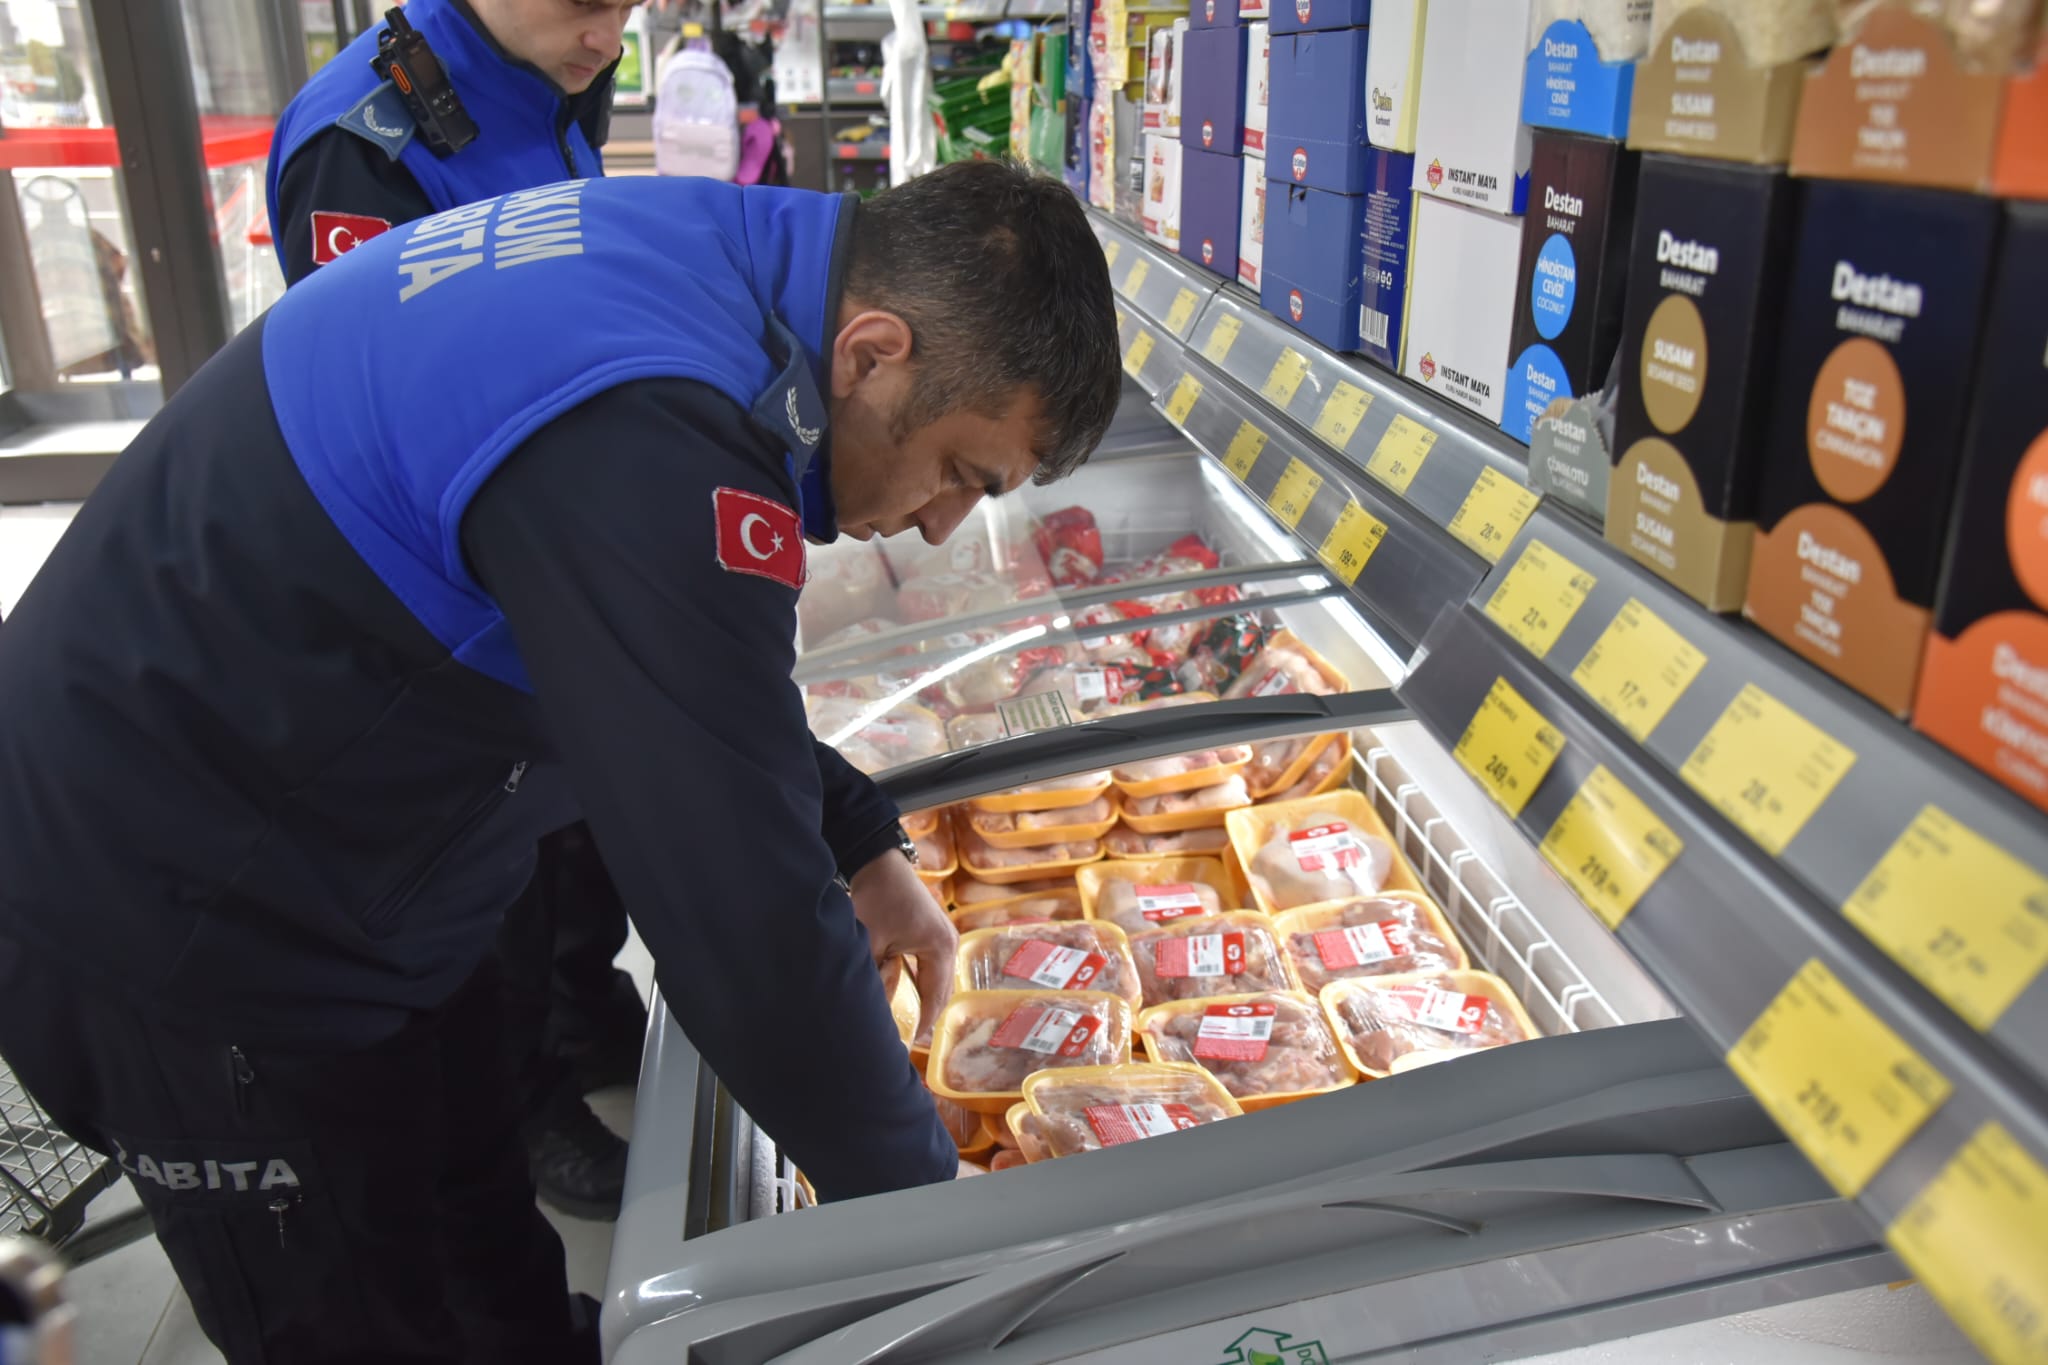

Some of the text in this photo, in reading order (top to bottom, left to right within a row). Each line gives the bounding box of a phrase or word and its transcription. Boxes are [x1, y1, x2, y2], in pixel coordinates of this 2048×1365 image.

[1545, 38, 1577, 58] Destan
[1671, 36, 1720, 62] Destan
[1448, 167, 1477, 187] INSTANT
[1477, 175, 1497, 190] MAYA
[1544, 186, 1583, 217] Destan
[1547, 215, 1575, 234] BAHARAT
[1656, 229, 1719, 274] Destan
[1831, 260, 1922, 317] Destan
[1653, 339, 1695, 369] SUSAM
[1441, 365, 1470, 391] INSTANT
[1470, 378, 1490, 398] MAYA
[1526, 364, 1556, 392] Destan
[1636, 462, 1680, 501] Destan
[1636, 513, 1674, 547] SUSAM
[1797, 531, 1862, 584] Destan
